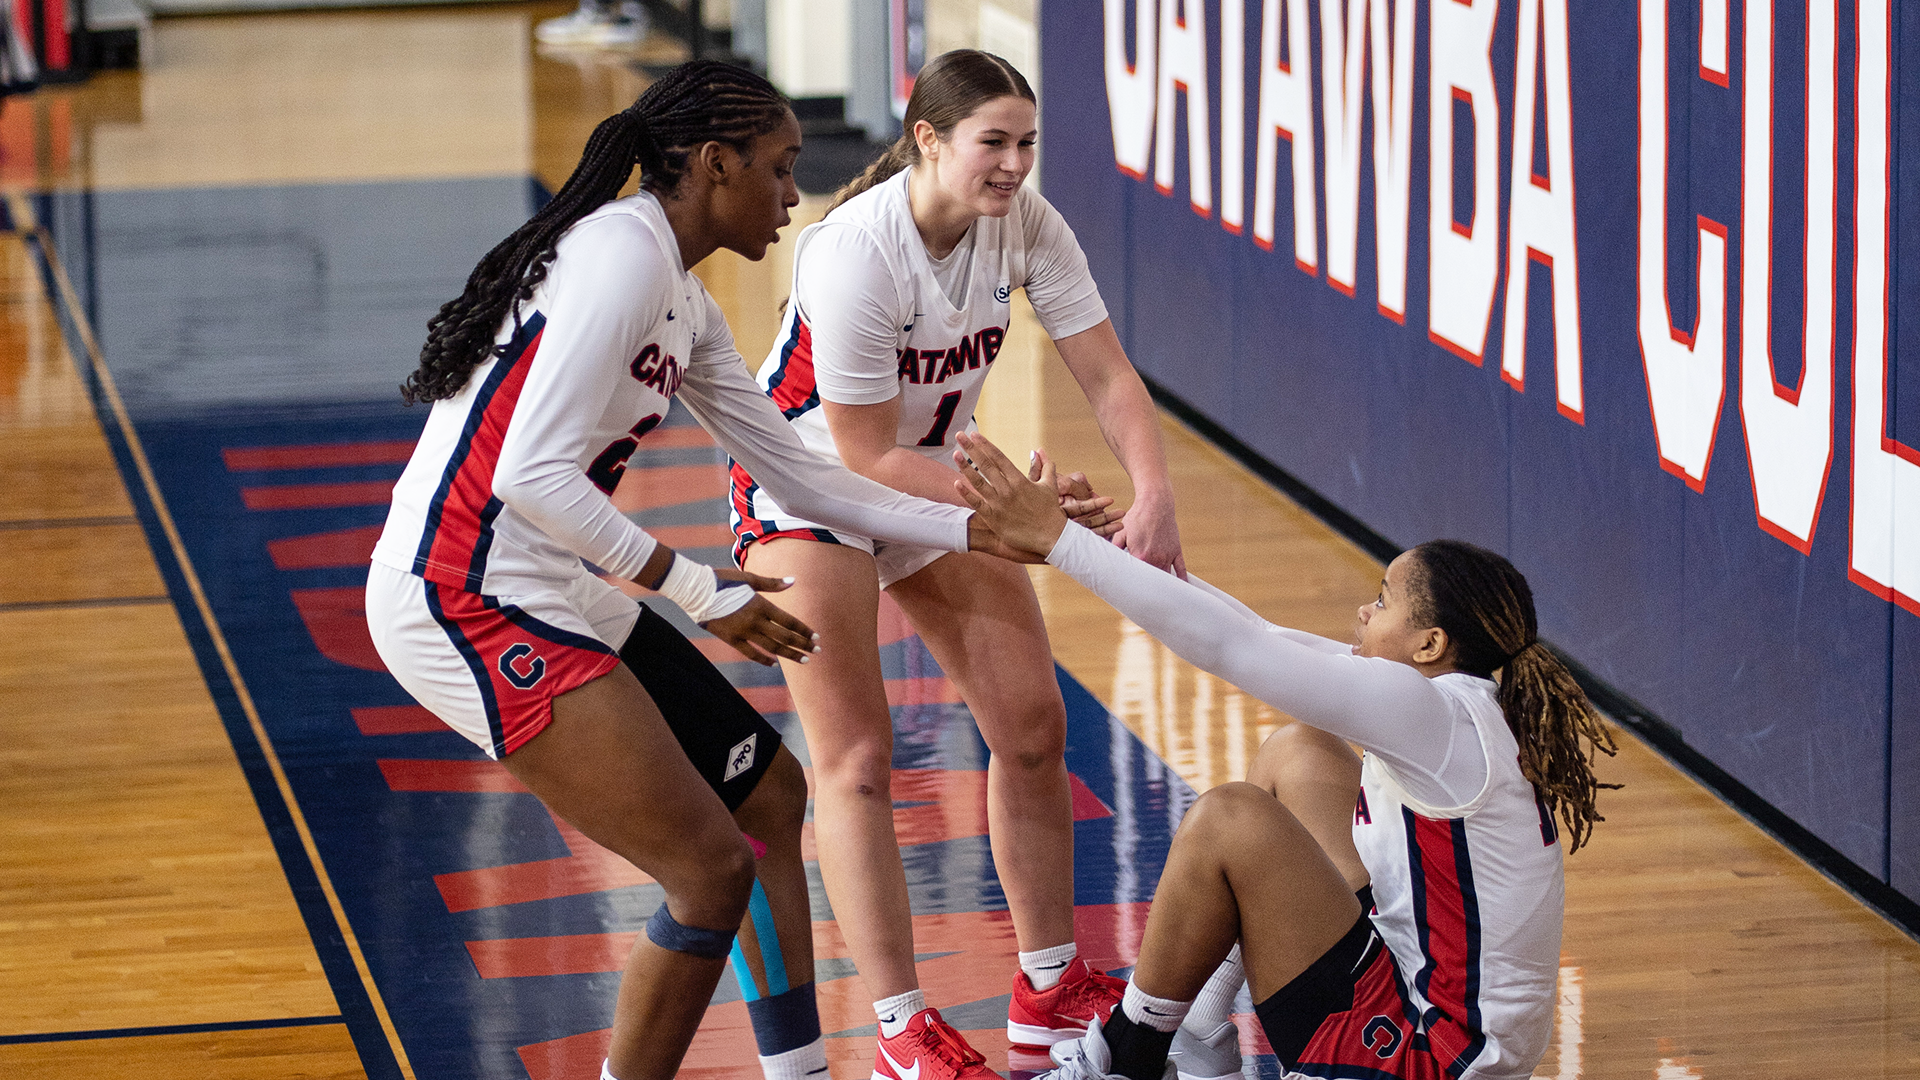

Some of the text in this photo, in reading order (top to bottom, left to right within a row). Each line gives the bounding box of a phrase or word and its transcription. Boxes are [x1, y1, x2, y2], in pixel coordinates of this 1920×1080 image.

[896, 318, 1011, 385] ATAWB
[916, 389, 963, 447] 1
[498, 642, 547, 690] C
[732, 743, 752, 772] PRO
[1361, 1014, 1404, 1060] C
